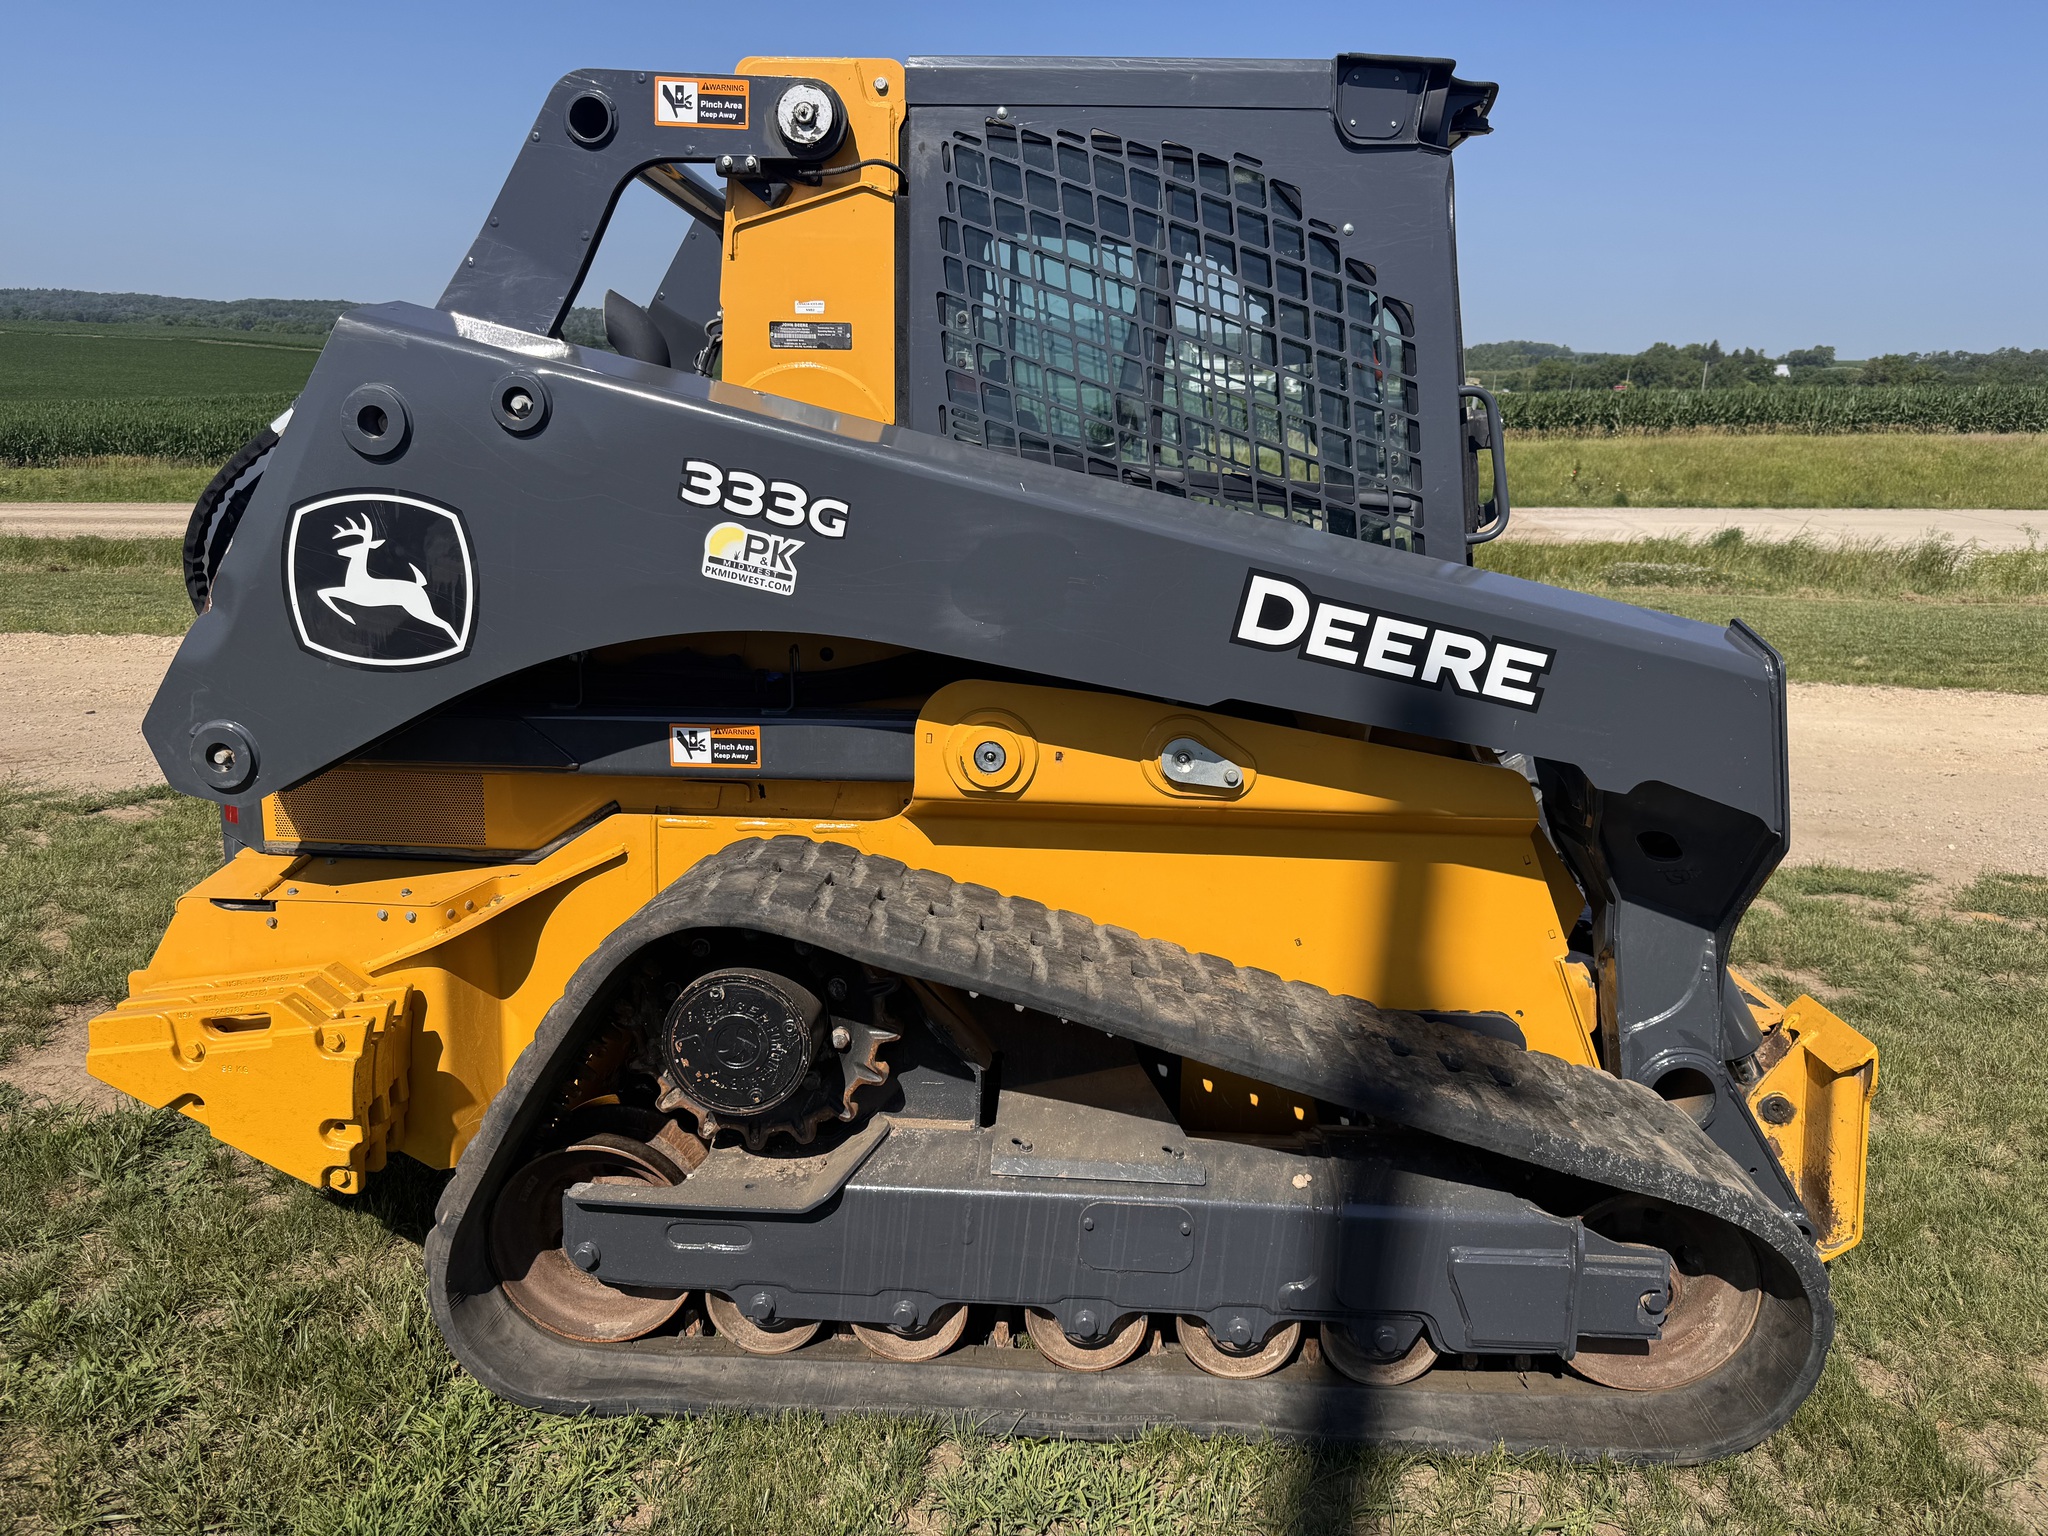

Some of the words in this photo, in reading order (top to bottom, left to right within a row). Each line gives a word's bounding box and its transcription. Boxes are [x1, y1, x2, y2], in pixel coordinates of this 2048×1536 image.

[709, 83, 744, 92] WARNING
[700, 100, 723, 109] Pinch
[724, 101, 743, 110] Area
[700, 110, 718, 119] Keep
[718, 111, 737, 120] Away
[681, 460, 849, 538] 333G
[723, 559, 779, 579] MIDWEST
[704, 565, 792, 593] PKMIDWEST.COM
[1237, 574, 1549, 706] DEERE
[713, 743, 736, 751] Pinch
[714, 752, 731, 760] Keep
[731, 753, 749, 761] Away
[176, 1011, 194, 1020] USA
[236, 1065, 249, 1074] KG
